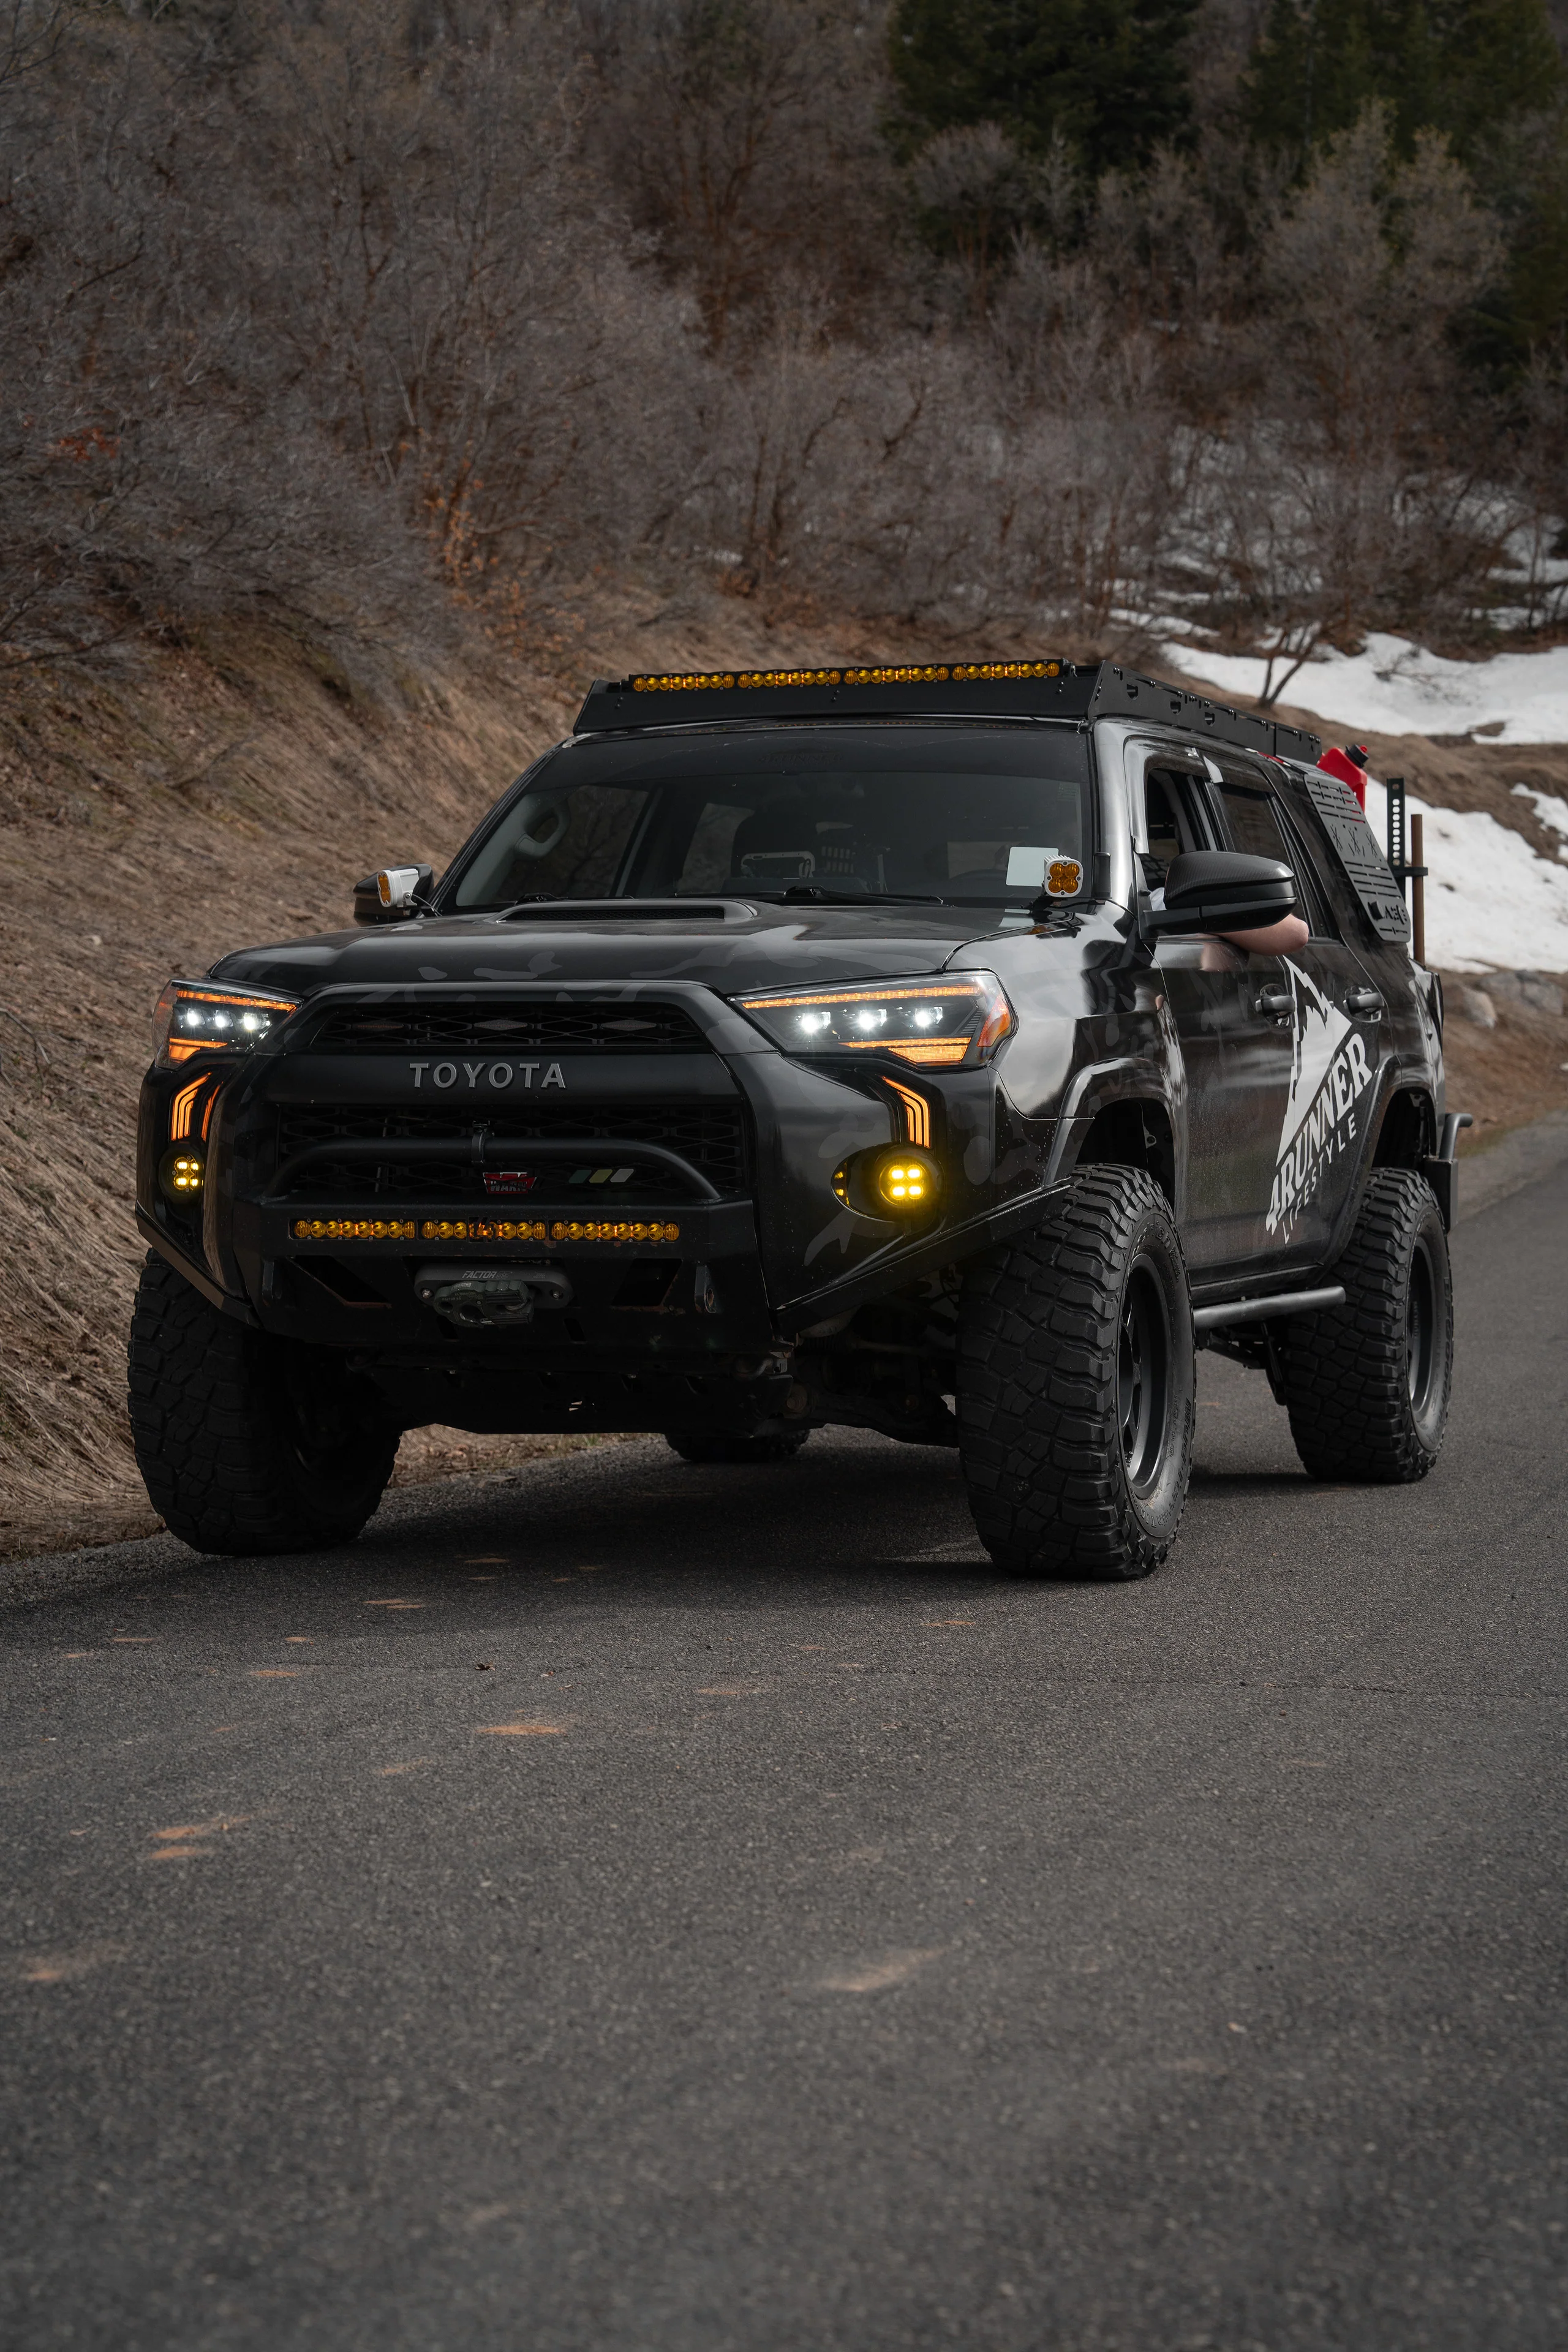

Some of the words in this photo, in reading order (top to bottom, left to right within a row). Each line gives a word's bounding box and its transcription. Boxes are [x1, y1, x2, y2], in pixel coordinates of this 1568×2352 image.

[409, 1062, 567, 1090] TOYOTA
[1265, 1033, 1372, 1235] 4RUNNER
[490, 1181, 528, 1192] WARN
[1283, 1112, 1356, 1245] LIFESTYLE
[462, 1270, 497, 1280] FACTOR
